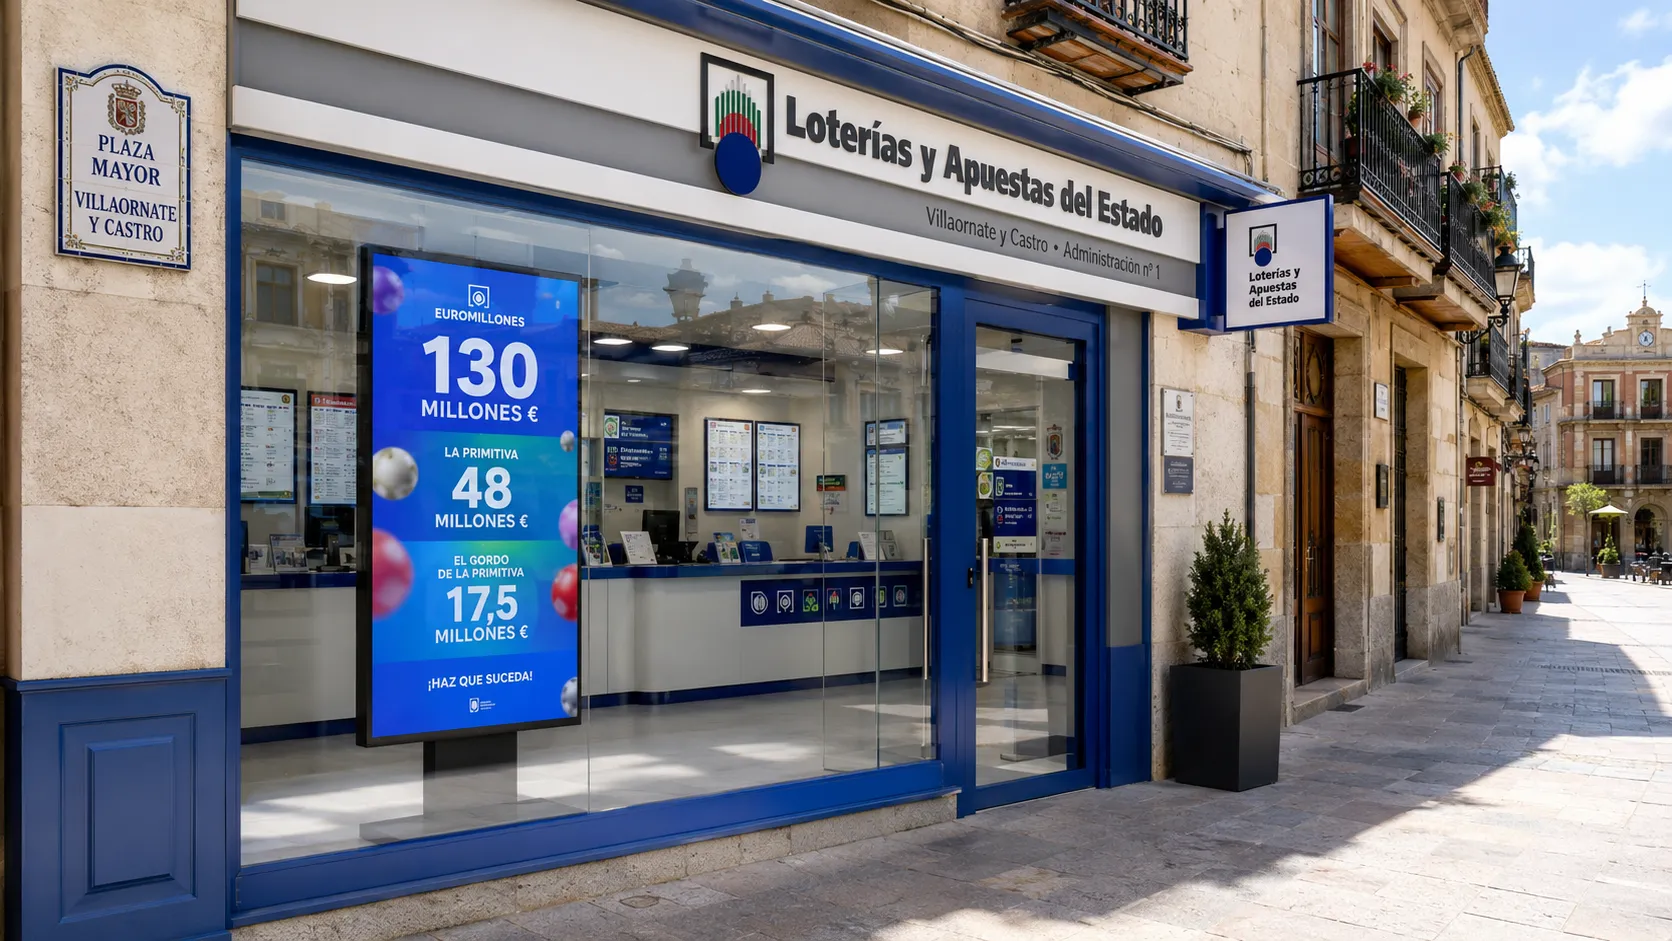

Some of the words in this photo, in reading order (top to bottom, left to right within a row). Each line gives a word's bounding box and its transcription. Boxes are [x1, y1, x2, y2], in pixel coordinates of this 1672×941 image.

[98, 134, 155, 161] PLAZA
[91, 157, 161, 186] MAYOR
[786, 95, 912, 167] Loterías
[920, 144, 937, 183] y
[943, 144, 1055, 208] Apuestas
[1060, 180, 1092, 219] del
[1098, 190, 1163, 238] Estado
[74, 190, 177, 222] VILLAORNATE
[89, 216, 99, 233] Y
[104, 218, 163, 242] CASTRO
[926, 206, 996, 240] Villaornate
[1000, 229, 1007, 247] y
[1010, 228, 1048, 252] Castro
[1063, 241, 1141, 275] Administración
[1156, 264, 1161, 280] 1
[1249, 268, 1291, 282] Loterías
[1294, 267, 1301, 278] y
[1249, 281, 1297, 296] Apuestas
[1249, 296, 1263, 307] del
[1266, 293, 1299, 306] Estado
[435, 307, 525, 327] EUROMILLONES
[422, 335, 538, 400] 130
[421, 399, 522, 422] MILLONES
[527, 406, 539, 422] €
[444, 447, 460, 458] LA
[463, 447, 519, 460] PRIMITIVA
[452, 466, 512, 509] 48
[435, 514, 515, 528] MILLONES
[519, 514, 528, 528] €
[454, 555, 467, 566] EL
[469, 554, 509, 566] GORDO
[438, 569, 452, 579] DE
[455, 568, 469, 578] LA
[472, 567, 524, 578] PRIMITIVA
[446, 585, 518, 626] 17,5
[435, 626, 516, 644] MILLONES
[519, 625, 528, 639] €
[428, 676, 456, 691] ¡HAZ
[459, 674, 483, 687] QUE
[486, 670, 533, 685] SUCEDA!
